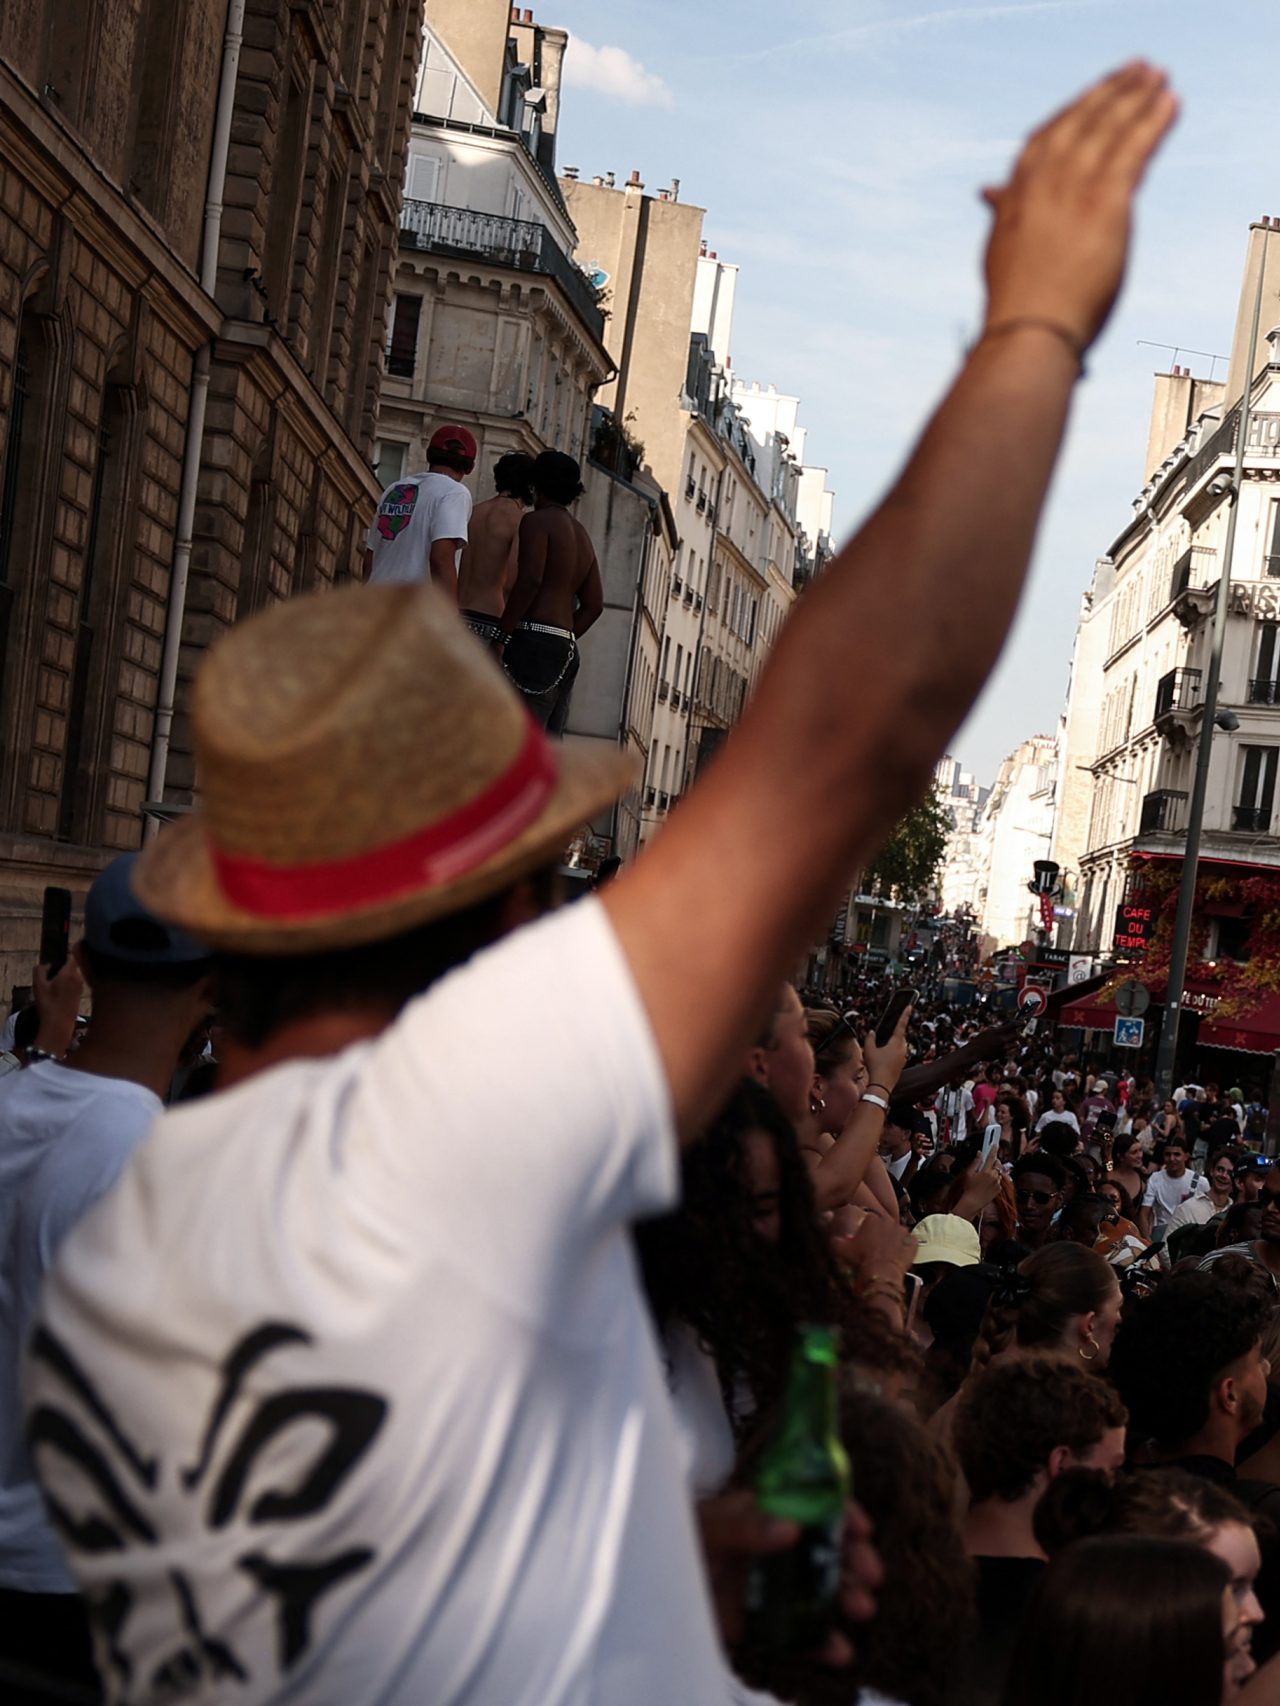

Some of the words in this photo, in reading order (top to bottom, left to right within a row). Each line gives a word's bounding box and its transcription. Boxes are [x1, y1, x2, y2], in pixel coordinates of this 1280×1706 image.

[1123, 906, 1151, 921] CAFE
[1128, 922, 1144, 934] DU
[1115, 934, 1150, 950] TEMPL
[1044, 953, 1068, 963] TABAC
